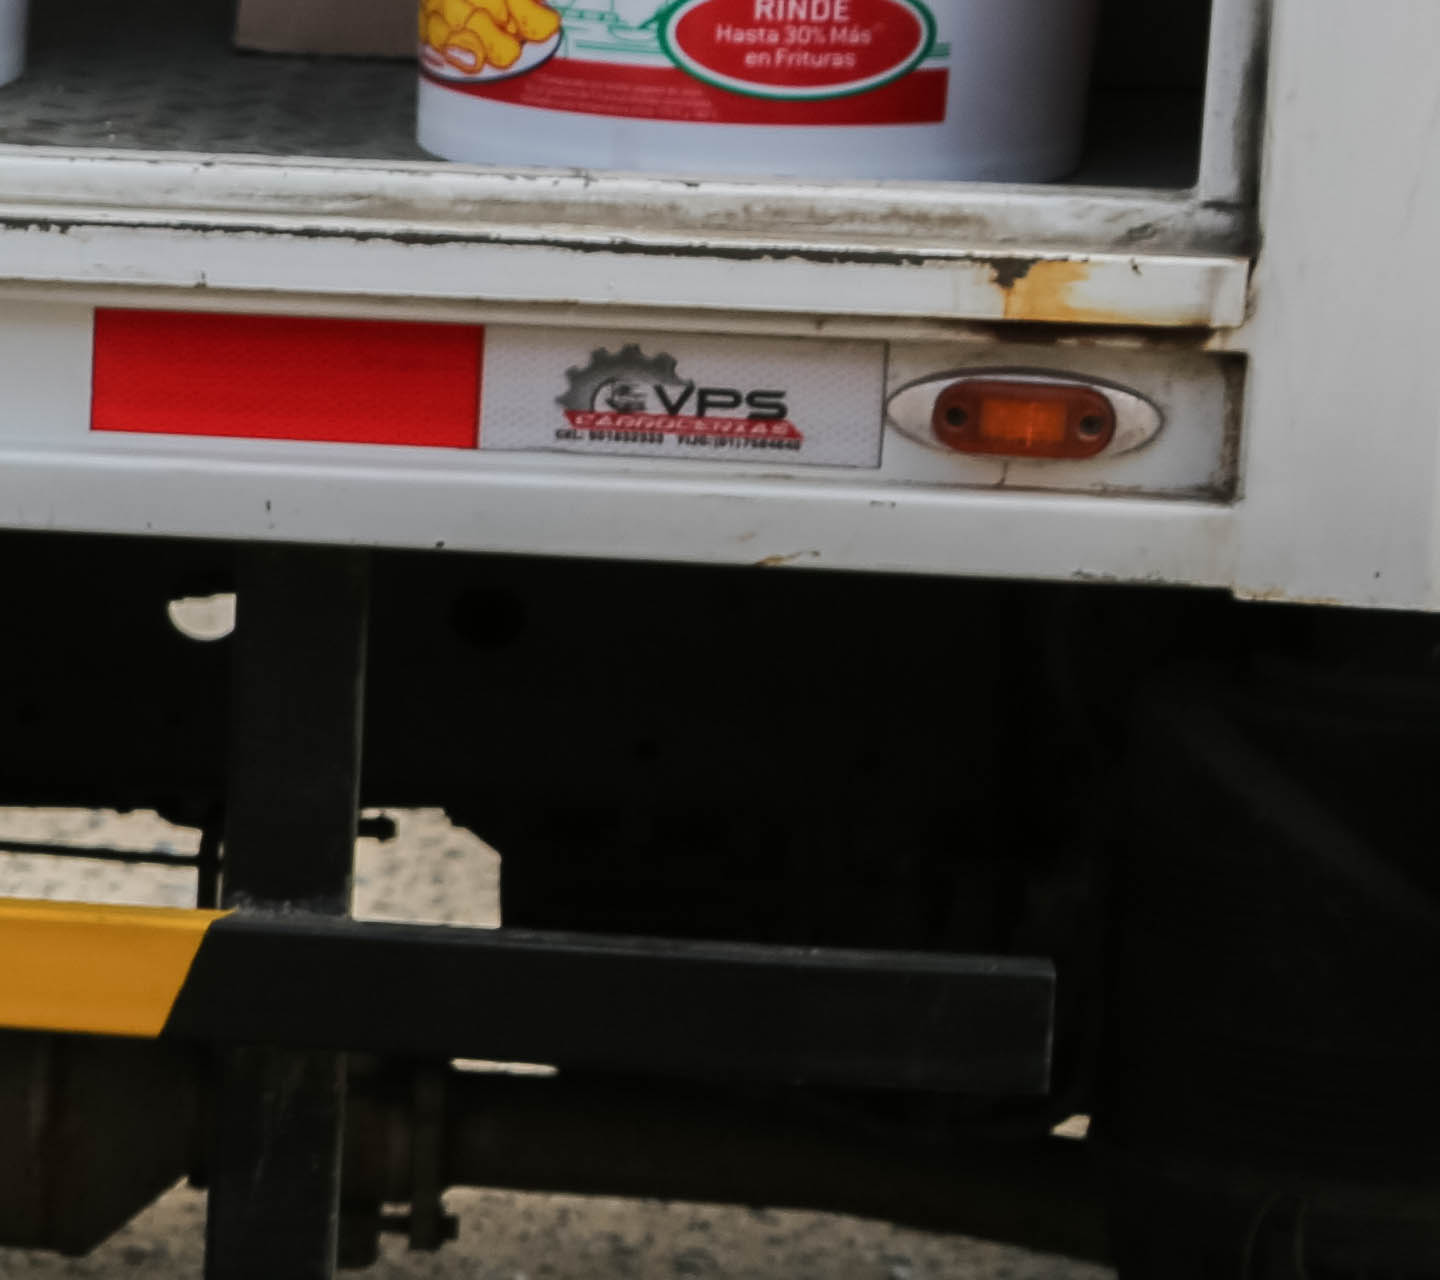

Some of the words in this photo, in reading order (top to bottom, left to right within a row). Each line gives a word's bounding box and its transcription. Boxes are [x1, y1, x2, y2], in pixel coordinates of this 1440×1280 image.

[715, 23, 779, 46] Hasta
[783, 23, 827, 47] 30%
[744, 51, 770, 69] en
[774, 47, 857, 70] Frituras
[653, 378, 789, 421] VPS
